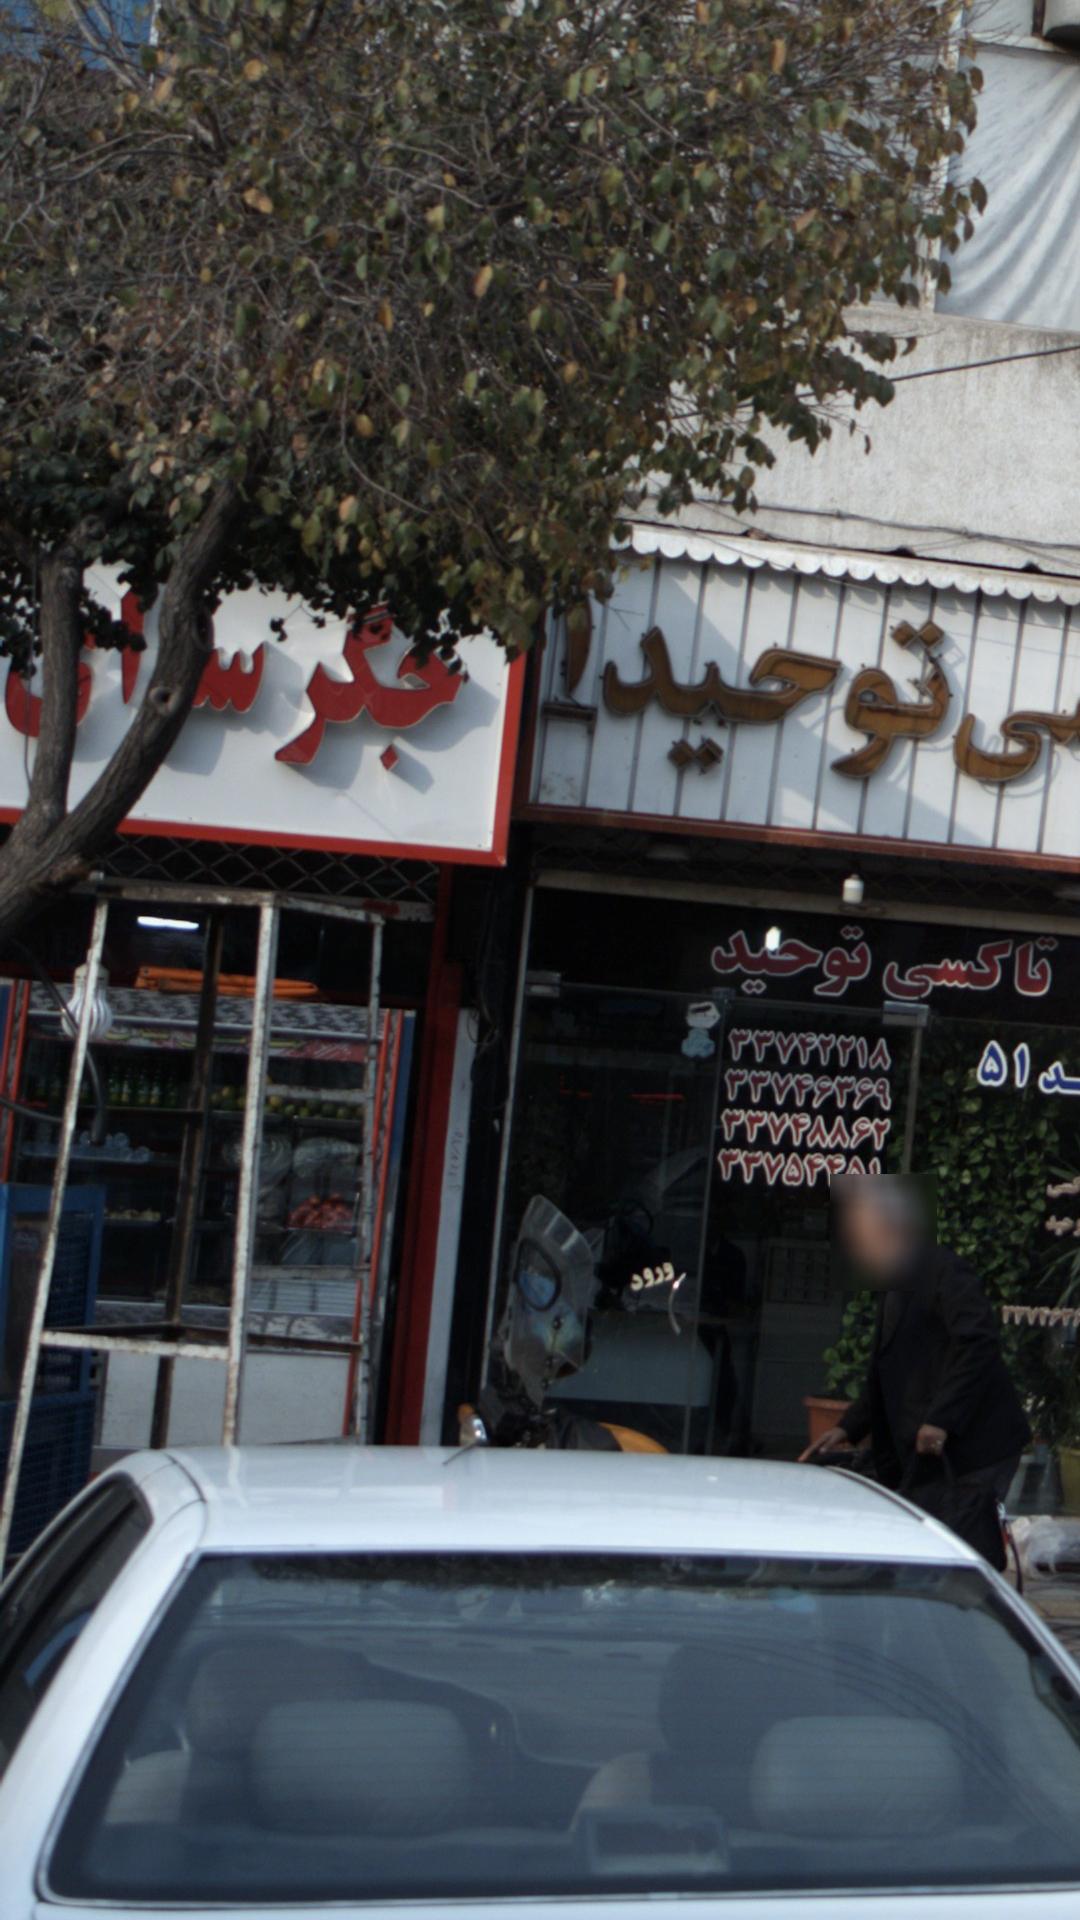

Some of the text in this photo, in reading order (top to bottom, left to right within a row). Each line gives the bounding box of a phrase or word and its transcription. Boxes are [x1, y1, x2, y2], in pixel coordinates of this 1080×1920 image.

[602, 619, 951, 779] توحید
[711, 925, 1058, 1000] تاکسی توحید
[728, 1027, 892, 1072] ۳۳۷۴۲۲۱۸
[976, 1039, 1030, 1088] ۵۱
[724, 1068, 892, 1111] ۳۳۷۴۶۳۶۹
[720, 1108, 891, 1151] ۳۳۷۴۸۸۶۲
[629, 1261, 675, 1292] ورود
